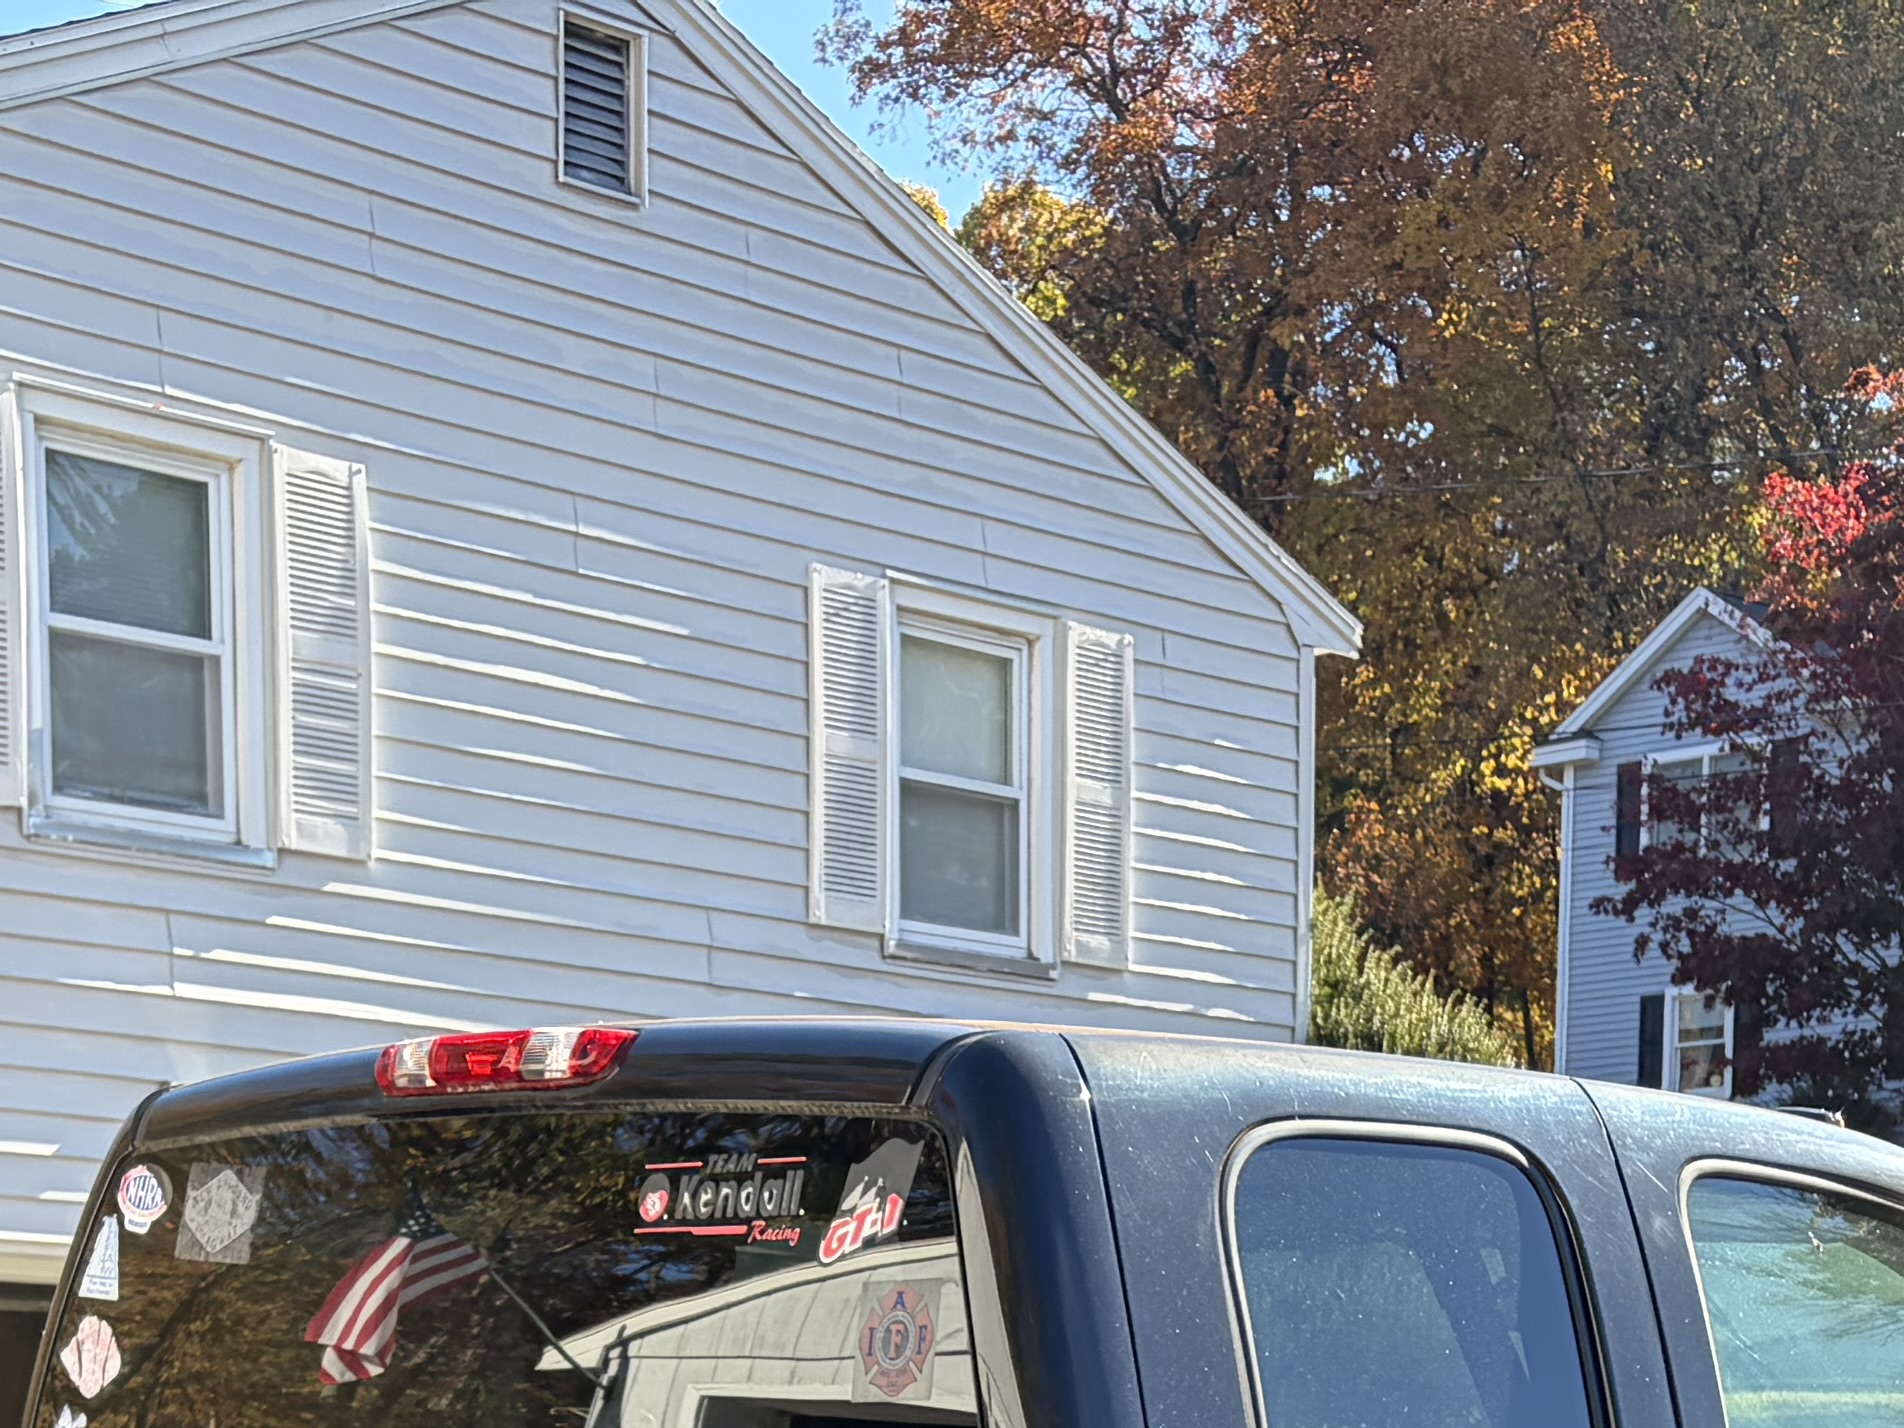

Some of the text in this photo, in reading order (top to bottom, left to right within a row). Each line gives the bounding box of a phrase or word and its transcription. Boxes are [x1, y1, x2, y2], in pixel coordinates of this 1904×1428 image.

[706, 1153, 757, 1173] TEAM
[126, 1174, 163, 1210] NHRA
[674, 1169, 804, 1219] Kendall
[747, 1220, 801, 1247] Racing
[891, 1291, 907, 1312] A
[887, 1323, 905, 1360] F
[916, 1325, 927, 1355] F
